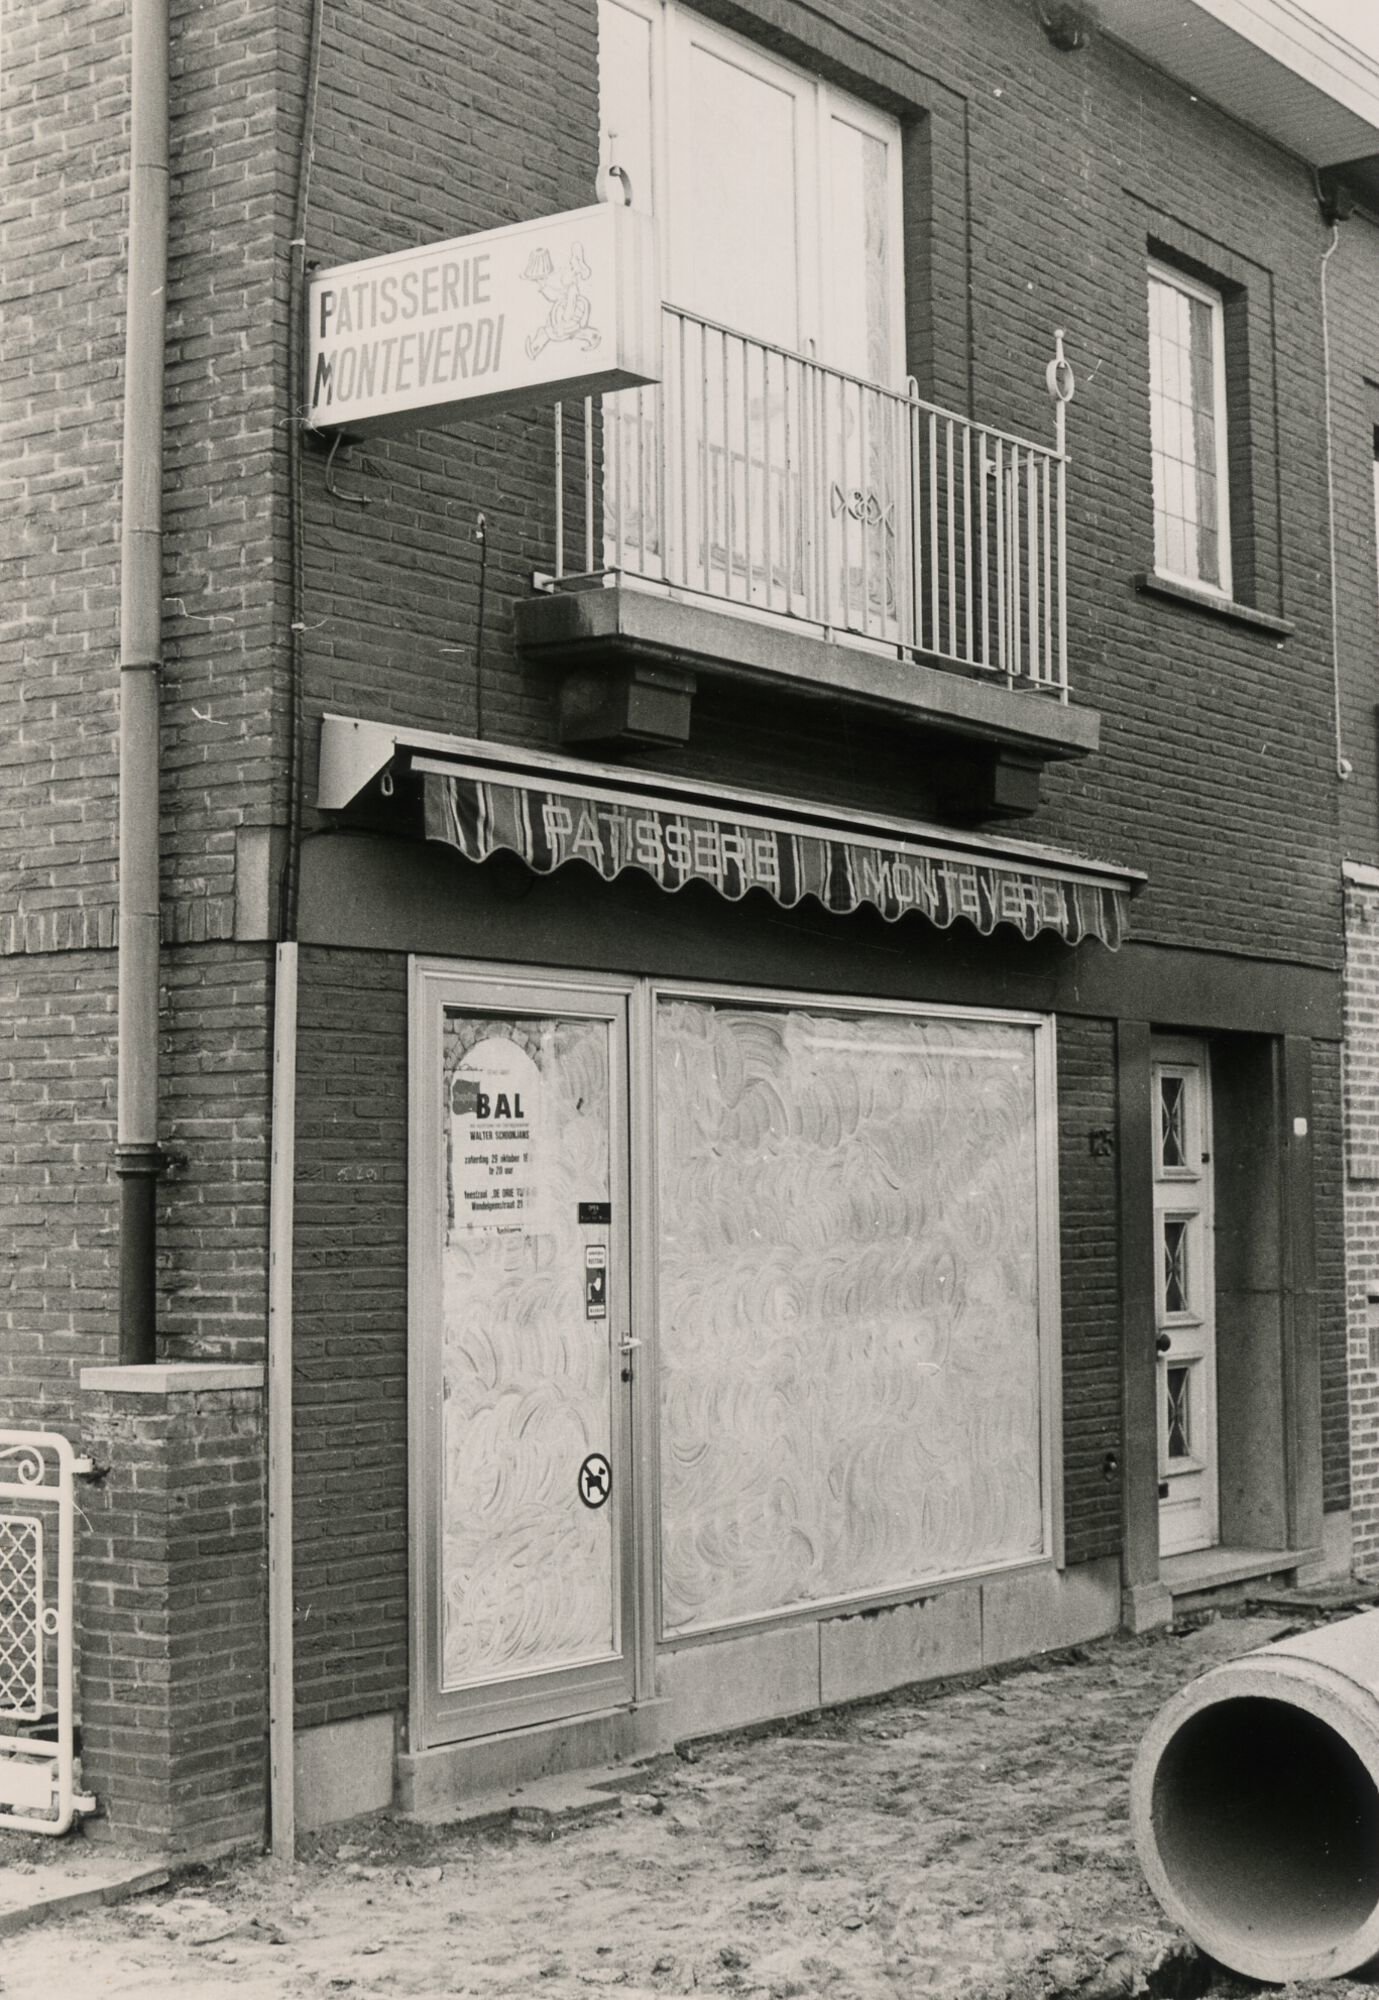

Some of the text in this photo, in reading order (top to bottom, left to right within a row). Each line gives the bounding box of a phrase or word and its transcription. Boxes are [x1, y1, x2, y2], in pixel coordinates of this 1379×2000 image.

[319, 253, 491, 339] PATISSERIE
[311, 313, 506, 409] MONTEVERDI
[541, 803, 1069, 925] PATISSERIE MONTEVERDI
[476, 1093, 524, 1119] BAL
[464, 1154, 489, 1166] zaterdag
[500, 1153, 520, 1163] oktober
[469, 1130, 493, 1141] WALTER
